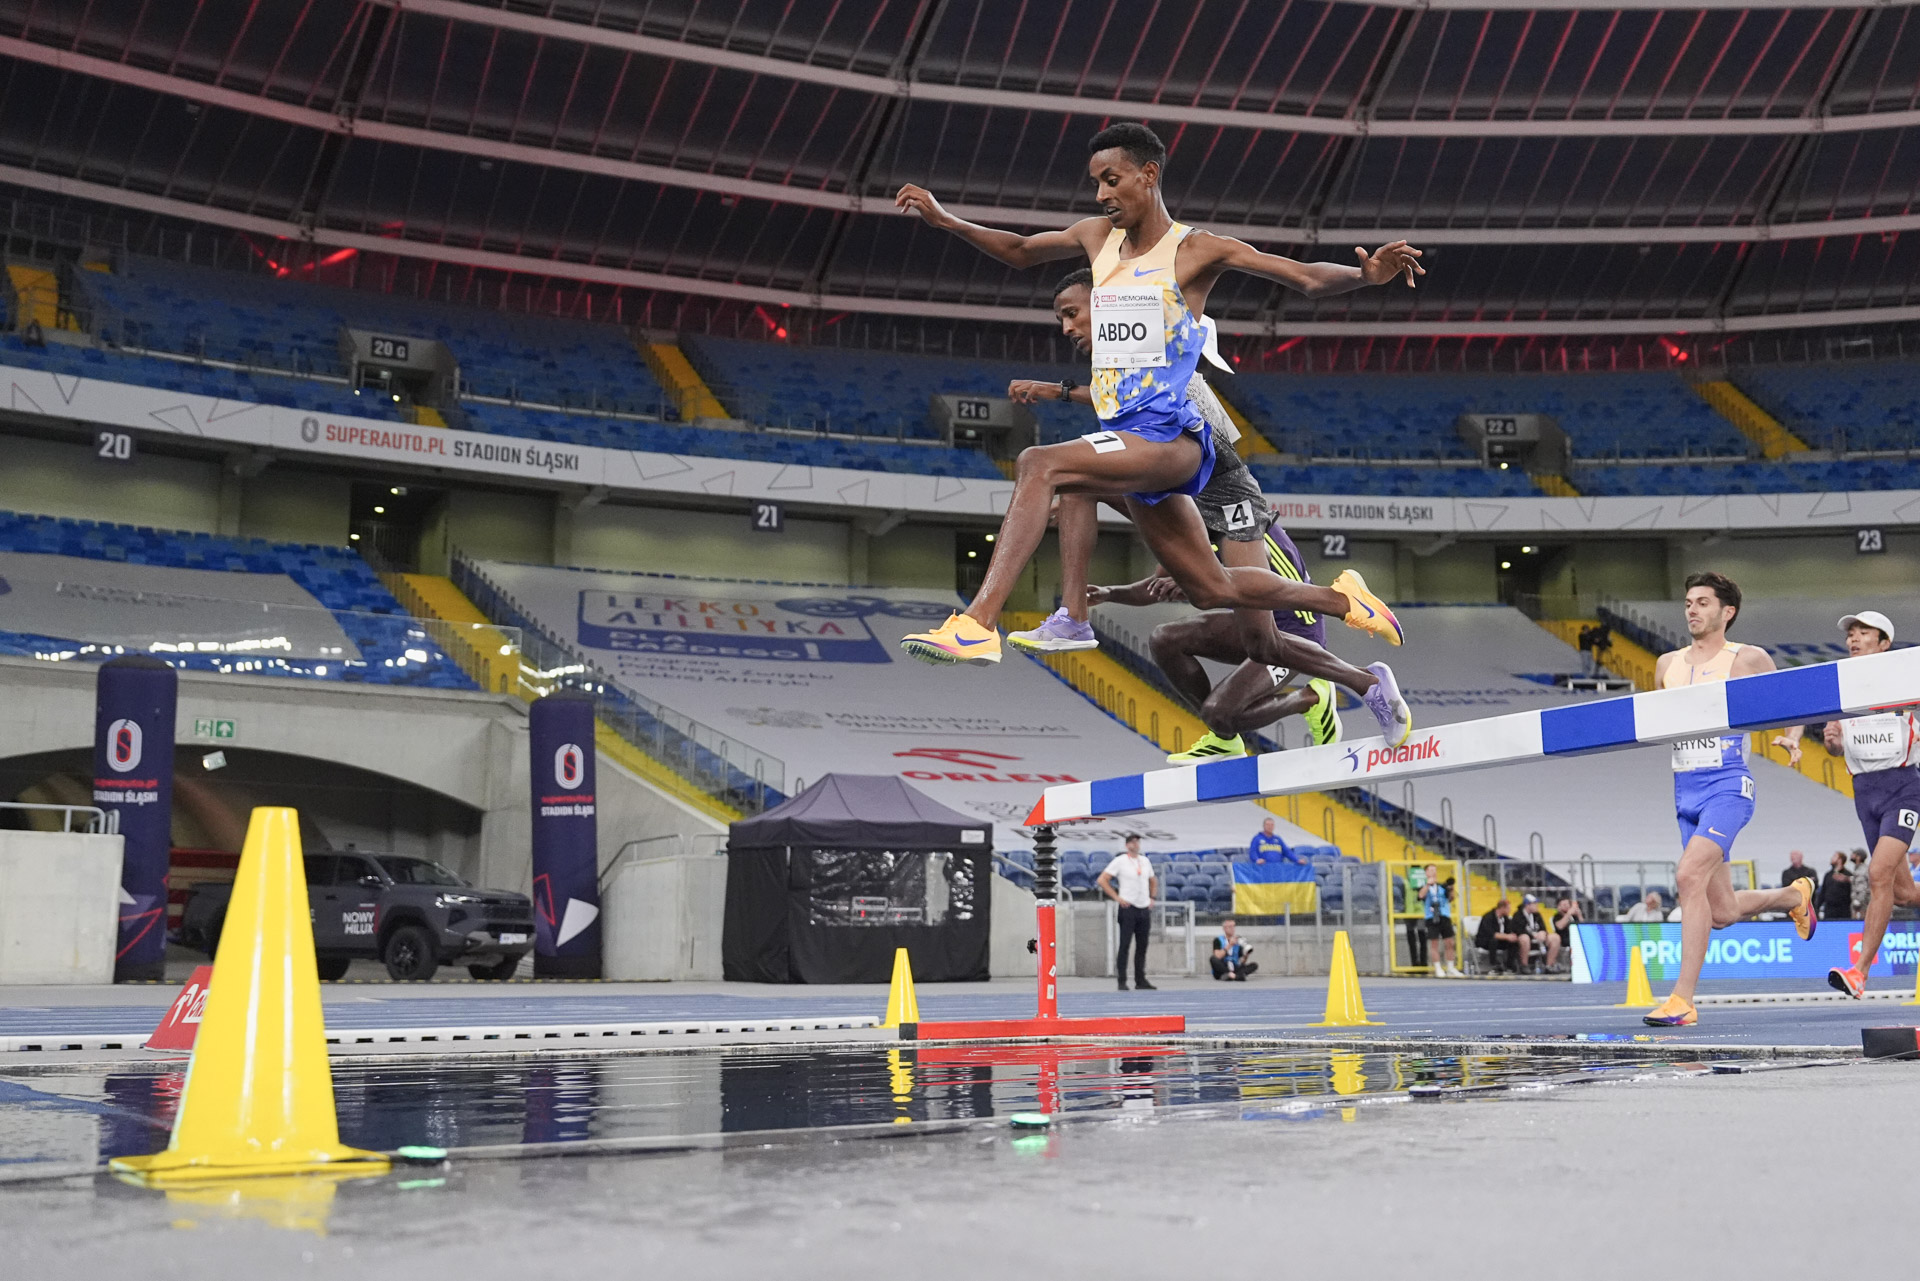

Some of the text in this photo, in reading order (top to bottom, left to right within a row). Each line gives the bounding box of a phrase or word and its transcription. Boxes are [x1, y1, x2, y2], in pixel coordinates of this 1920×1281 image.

[1097, 322, 1147, 342] ABDO
[374, 340, 394, 355] 20
[960, 402, 976, 418] 21
[99, 432, 131, 460] 20
[326, 424, 579, 473] SUPERAUTO.PL STADION ŚLĄSKI
[757, 505, 778, 528] 21
[1231, 503, 1249, 526] 4
[1329, 504, 1385, 520] STADION
[1388, 501, 1434, 524] ŚLĄSKI
[1323, 535, 1346, 556] 22
[1858, 529, 1882, 551] 23
[608, 595, 760, 616] LEKKO
[608, 612, 845, 635] ATLETYKA
[1853, 732, 1895, 745] NIINAE
[1366, 734, 1441, 773] polanik
[902, 770, 1082, 783] ORLEN
[541, 805, 573, 817] STADION
[1904, 812, 1915, 827] 6
[342, 911, 375, 923] NOWY
[344, 923, 374, 935] HILUX
[1639, 938, 1794, 965] PRMOCJE
